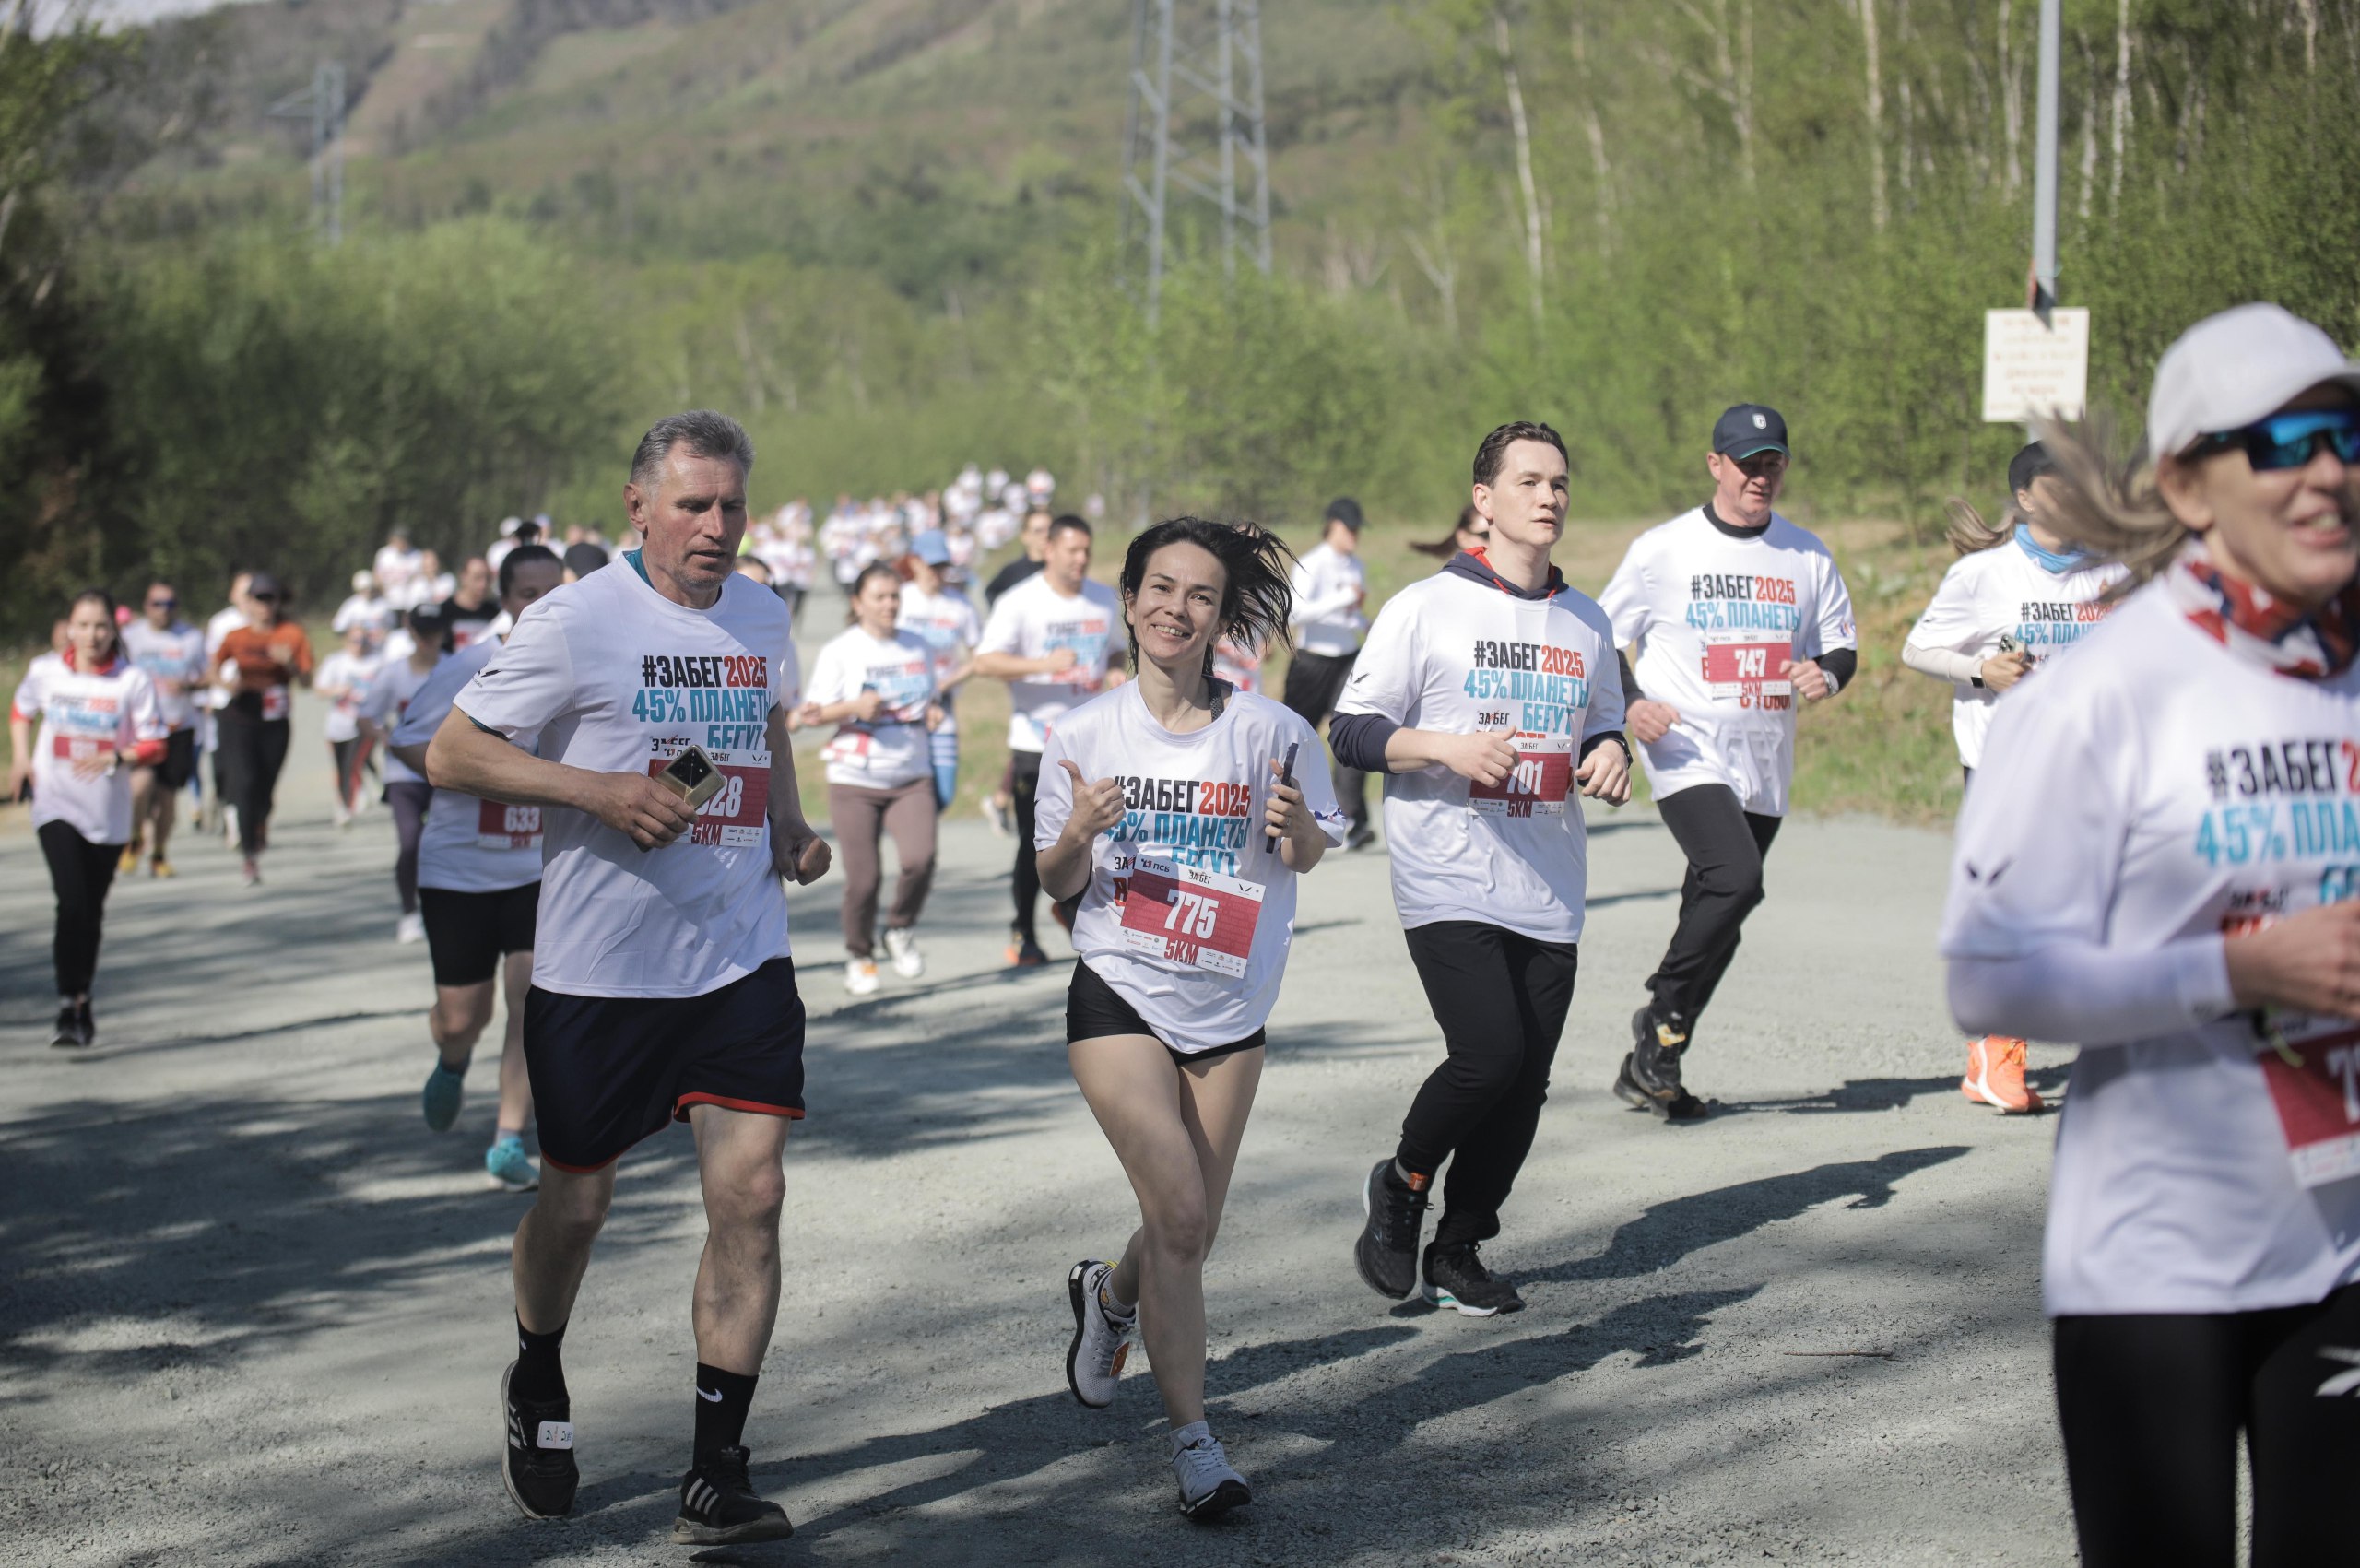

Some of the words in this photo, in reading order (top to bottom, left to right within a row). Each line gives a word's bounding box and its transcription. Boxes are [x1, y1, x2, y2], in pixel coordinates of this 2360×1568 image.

[1691, 574, 1796, 605] #ЗАБЕГ2025
[1685, 602, 1724, 630] 45%
[1727, 602, 1801, 632] ПЛАНЕТЫ
[2021, 602, 2113, 622] #ЗАБЕГ202
[2015, 623, 2049, 644] 45%
[642, 655, 768, 689] #ЗАБЕГ2025
[1474, 640, 1585, 678] #ЗАБЕГ2025
[1734, 648, 1767, 678] 747
[1463, 669, 1507, 700] 45%
[1510, 671, 1590, 709] ПЛАНЕТЫ
[632, 690, 687, 723] 45%
[690, 690, 772, 723] ПЛАНЕТЫ
[1522, 702, 1575, 735] БЕГУТ
[707, 725, 764, 750] БЕГУТ
[1506, 760, 1544, 795] 701
[2205, 738, 2360, 801] #ЗАБЕГ2
[1153, 814, 1252, 849] ПЛАНЕТЫ
[2195, 805, 2286, 869] 45%
[1153, 863, 1170, 873] ПСБ
[1171, 846, 1236, 878] БЕГУТ
[1164, 888, 1221, 939] 775
